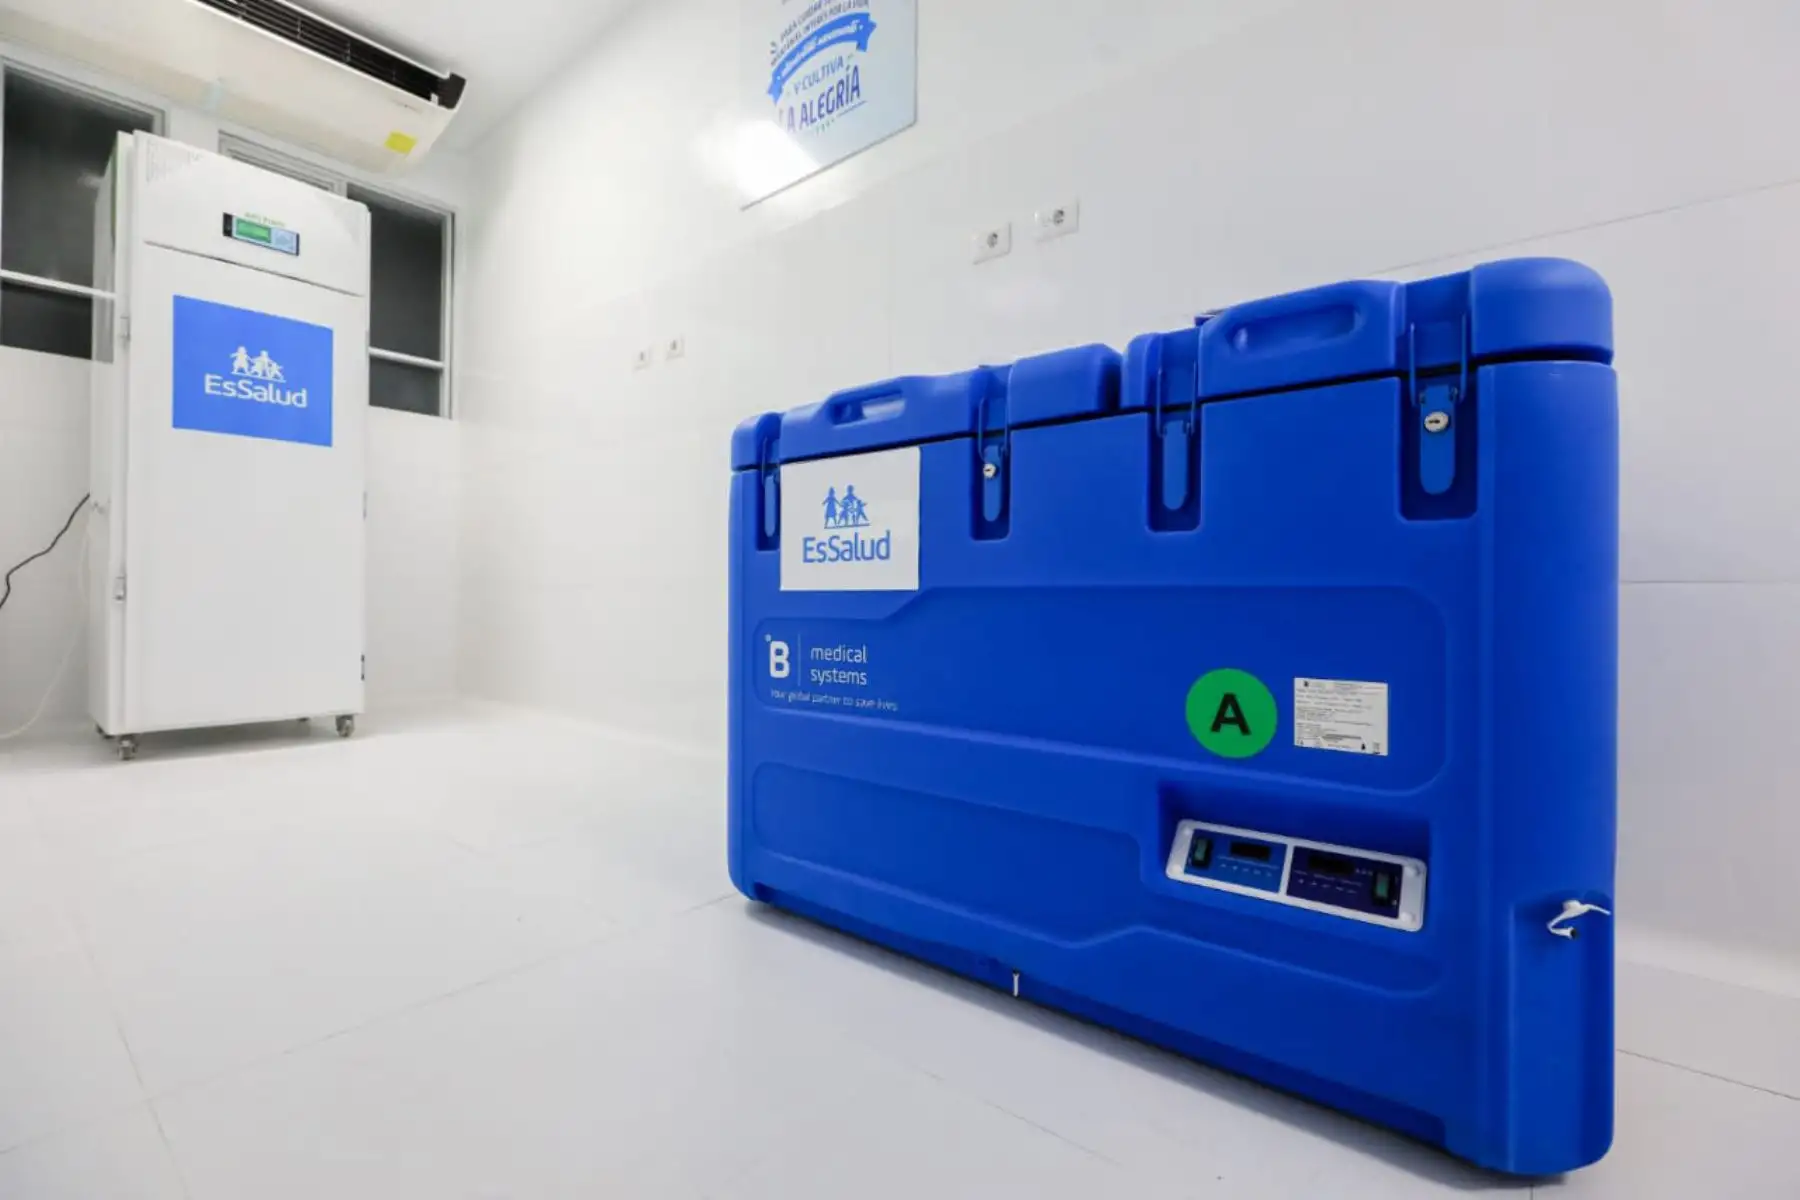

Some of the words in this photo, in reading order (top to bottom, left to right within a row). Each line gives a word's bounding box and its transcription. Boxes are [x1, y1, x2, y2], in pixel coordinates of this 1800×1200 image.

[802, 55, 844, 91] CULTIVA
[799, 64, 860, 130] ALEGRÍA
[204, 372, 307, 408] EsSalud
[802, 529, 890, 563] EsSalud
[810, 643, 868, 663] medical
[810, 667, 868, 686] systems
[1210, 692, 1252, 736] A
